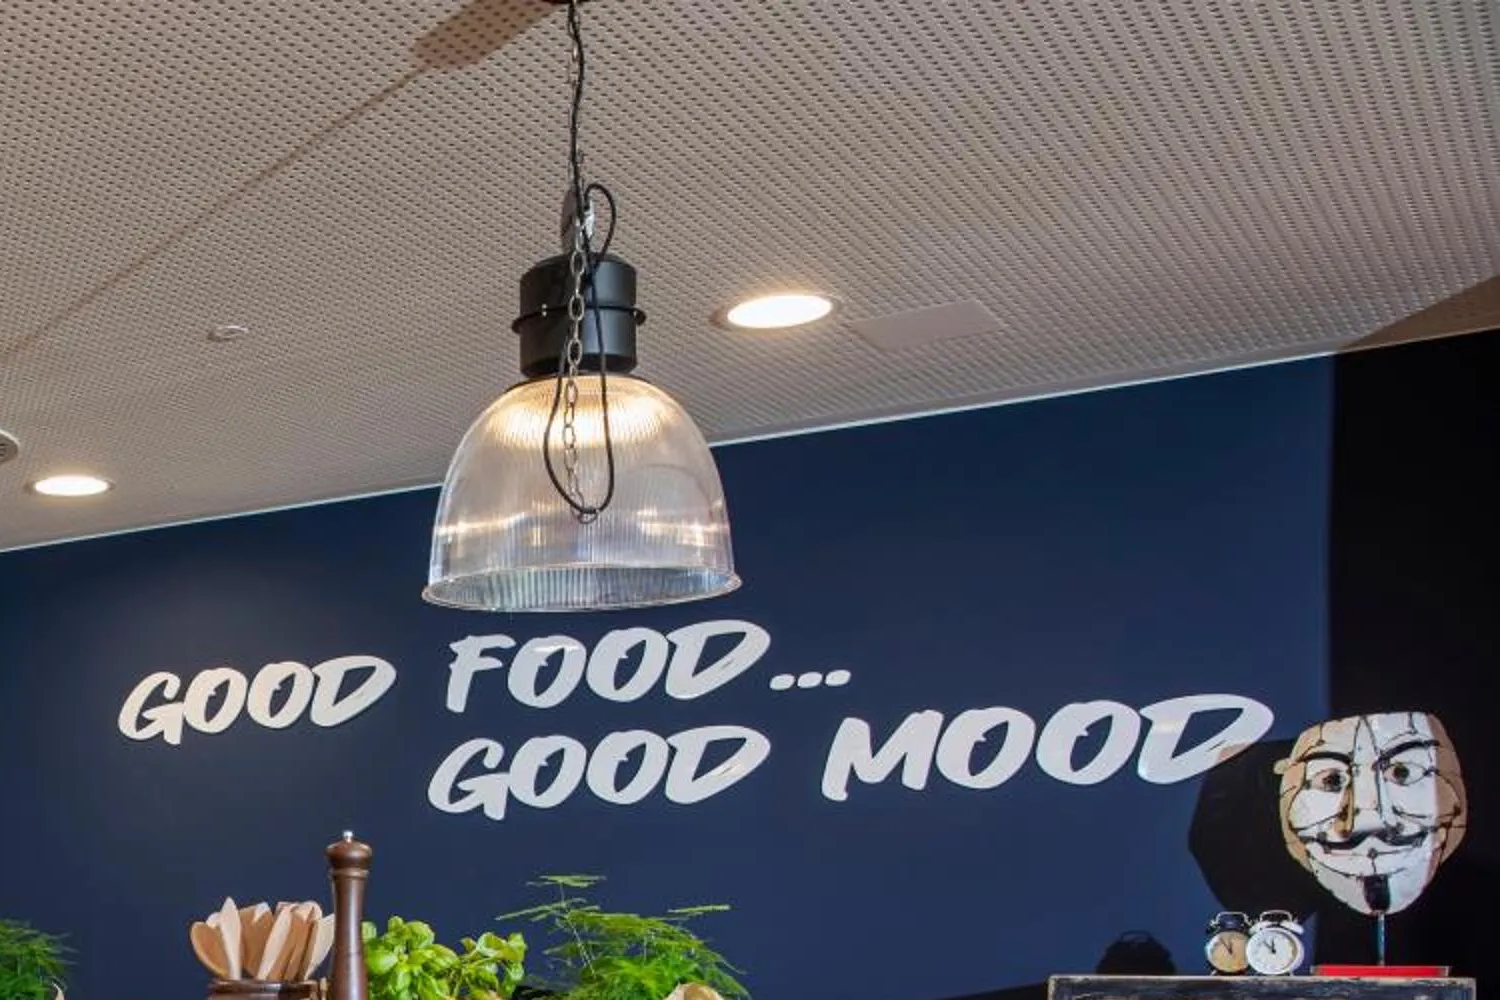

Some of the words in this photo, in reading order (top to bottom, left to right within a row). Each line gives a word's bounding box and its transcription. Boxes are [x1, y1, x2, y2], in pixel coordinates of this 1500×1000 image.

[117, 654, 397, 746] GOOD
[446, 619, 852, 713] FOOD...
[427, 724, 772, 821] GOOD
[821, 693, 1275, 802] MOOD
